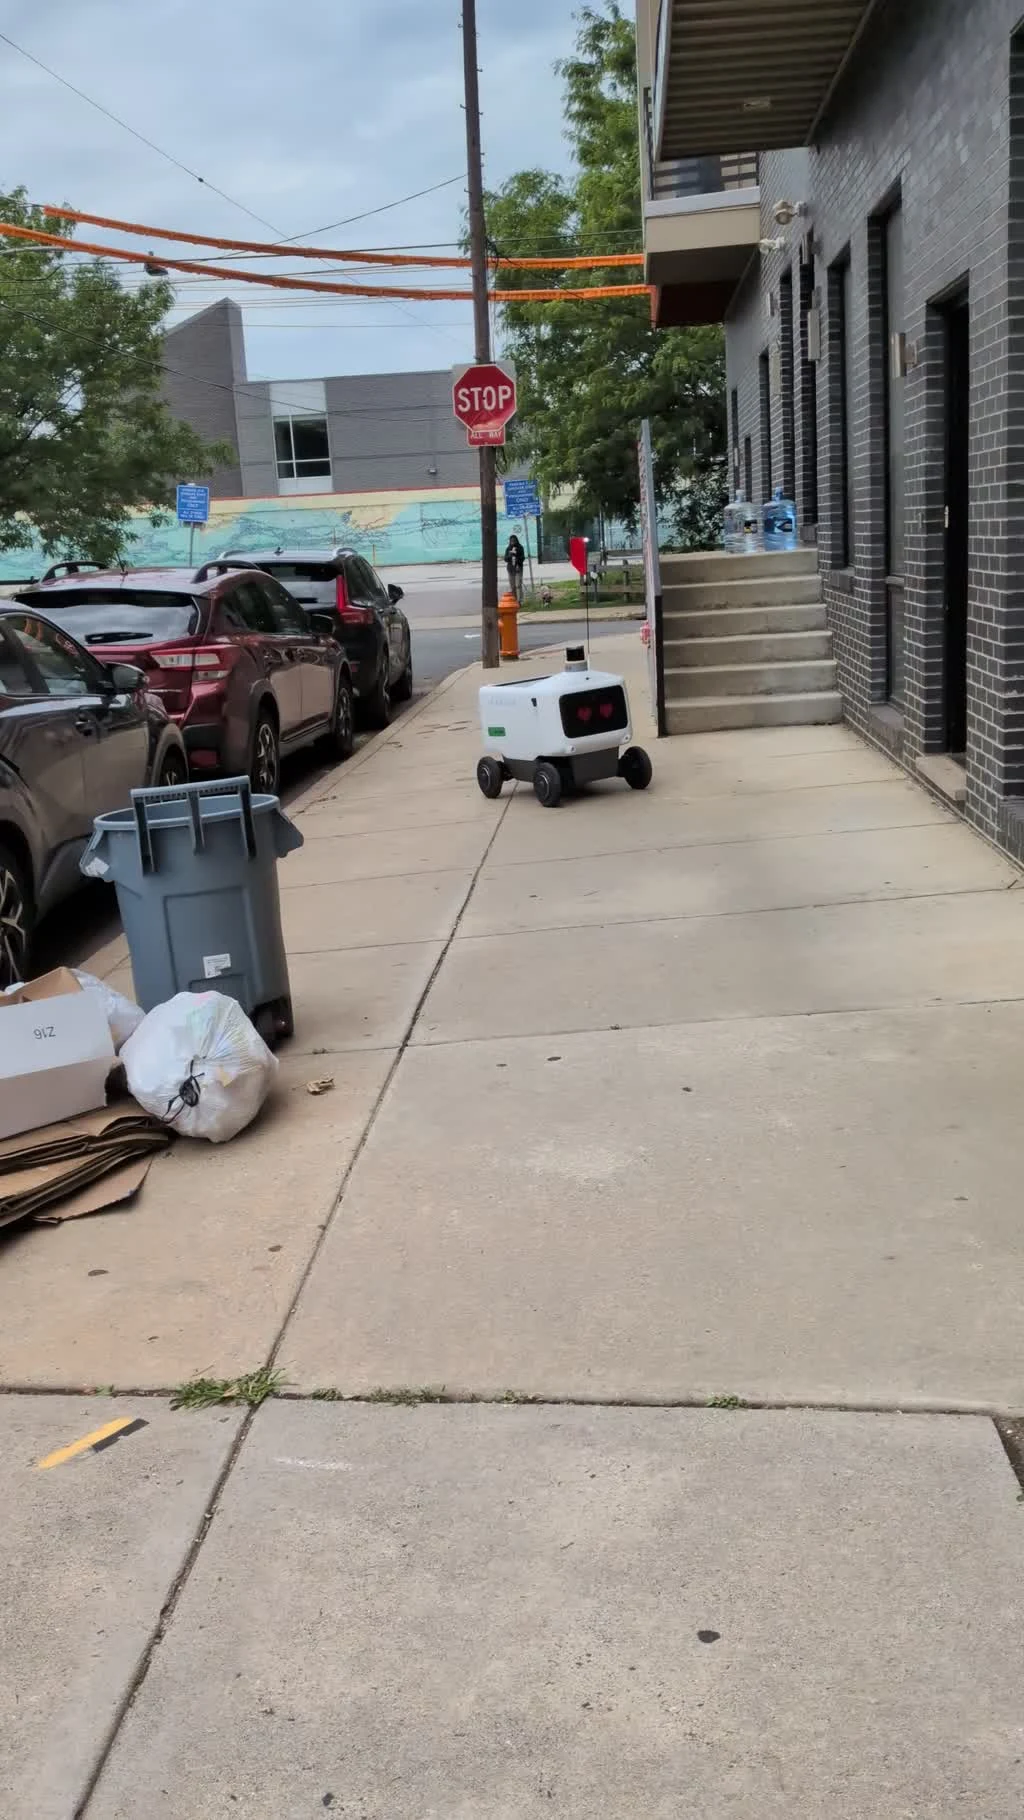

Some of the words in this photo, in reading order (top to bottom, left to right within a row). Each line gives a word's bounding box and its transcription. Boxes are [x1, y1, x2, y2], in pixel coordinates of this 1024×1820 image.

[458, 385, 512, 412] STOP
[470, 431, 482, 439] ALL
[488, 430, 502, 439] WAY
